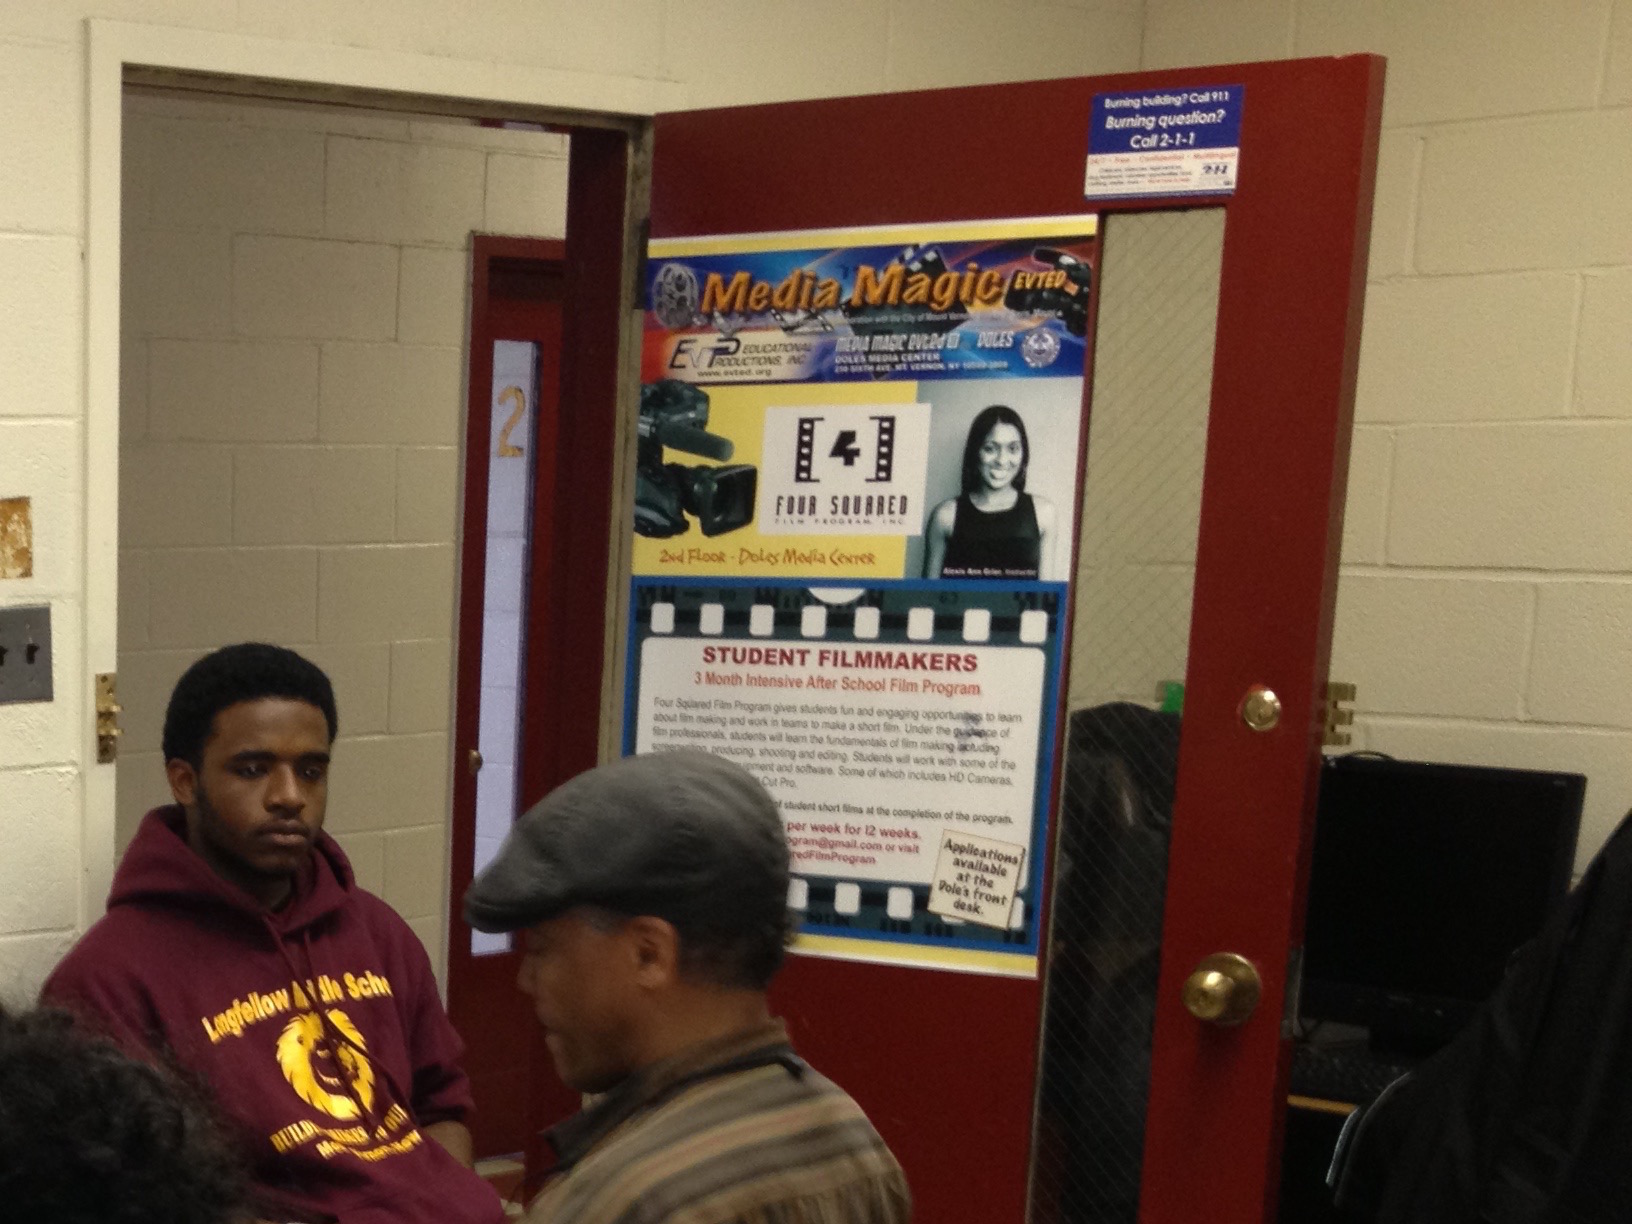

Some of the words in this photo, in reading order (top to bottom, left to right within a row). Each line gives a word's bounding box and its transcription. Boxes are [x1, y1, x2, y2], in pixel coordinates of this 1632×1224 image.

[1104, 96, 1142, 109] Burning
[1142, 93, 1188, 107] building?
[1189, 91, 1210, 103] Call
[1211, 91, 1230, 101] 911
[1105, 114, 1156, 130] Burning
[1158, 109, 1226, 129] question?
[1129, 135, 1159, 149] Call
[1159, 132, 1196, 147] 2-1-1
[700, 268, 842, 315] Media
[850, 262, 1005, 314] Magic
[1013, 269, 1069, 290] EVTED
[742, 343, 813, 354] EDUCATIONAL
[868, 353, 900, 364] MEDIA
[901, 352, 941, 363] CENTER
[497, 385, 526, 458] 2
[776, 494, 818, 516] FOUR
[831, 494, 909, 516] SQUARED
[658, 549, 684, 564] 2nd
[687, 549, 727, 564] Floor
[738, 548, 780, 566] Doles
[782, 548, 827, 565] Media
[829, 549, 876, 566] Center
[703, 646, 810, 667] STUDENT
[818, 649, 978, 673] FILMMAKERS
[694, 672, 702, 686] 3
[704, 671, 743, 687] Month
[745, 673, 803, 689] Intensive
[806, 674, 838, 691] After
[841, 676, 887, 692] School
[890, 678, 919, 693] Film
[921, 679, 982, 698] Program
[653, 696, 674, 708] Four
[675, 697, 712, 710] Squared
[713, 699, 733, 710] Film
[734, 700, 771, 714] Program
[773, 703, 798, 714] gives
[799, 703, 838, 716] students
[856, 706, 874, 717] and
[876, 708, 920, 721] engaging
[985, 711, 996, 722] to
[997, 712, 1023, 723] learn
[653, 713, 678, 723] about
[679, 713, 694, 723] film
[696, 714, 728, 727] making
[729, 716, 746, 727] and
[781, 718, 809, 729] teams
[810, 720, 820, 730] to
[821, 720, 847, 731] make
[857, 721, 881, 732] short
[904, 722, 934, 735] Under
[935, 725, 951, 736] the
[999, 727, 1011, 738] of
[729, 730, 767, 742] students
[784, 732, 808, 743] learn
[809, 733, 825, 745] the
[826, 734, 887, 748] fundamentals
[889, 737, 901, 749] of
[920, 739, 955, 753] making
[758, 746, 797, 761] shooting
[798, 748, 816, 760] and
[852, 750, 894, 764] Students
[912, 753, 935, 766] work
[937, 754, 957, 767] with
[959, 758, 987, 769] some
[988, 758, 999, 769] of
[1000, 758, 1017, 771] the
[776, 762, 794, 774] and
[837, 765, 865, 778] Some
[867, 766, 878, 778] of
[878, 768, 906, 780] which
[907, 770, 947, 783] includes
[948, 771, 965, 783] HD
[784, 800, 817, 813] student
[817, 803, 841, 813] short
[842, 803, 864, 815] films
[866, 805, 876, 815] at
[876, 806, 891, 817] the
[891, 807, 942, 821] completion
[943, 810, 954, 821] of
[955, 811, 971, 822] the
[972, 813, 1015, 826] program.
[786, 822, 808, 834] per
[810, 822, 842, 835] week
[843, 823, 863, 836] for
[786, 836, 884, 852] ogram@gmail.com
[884, 841, 896, 852] or
[898, 844, 921, 855] visit
[943, 837, 1019, 866] Applications
[790, 850, 877, 867] redFilmProgram
[952, 857, 1008, 878] available
[956, 871, 972, 884] at
[973, 873, 995, 890] the
[953, 898, 985, 917] desk.
[973, 887, 1009, 907] front
